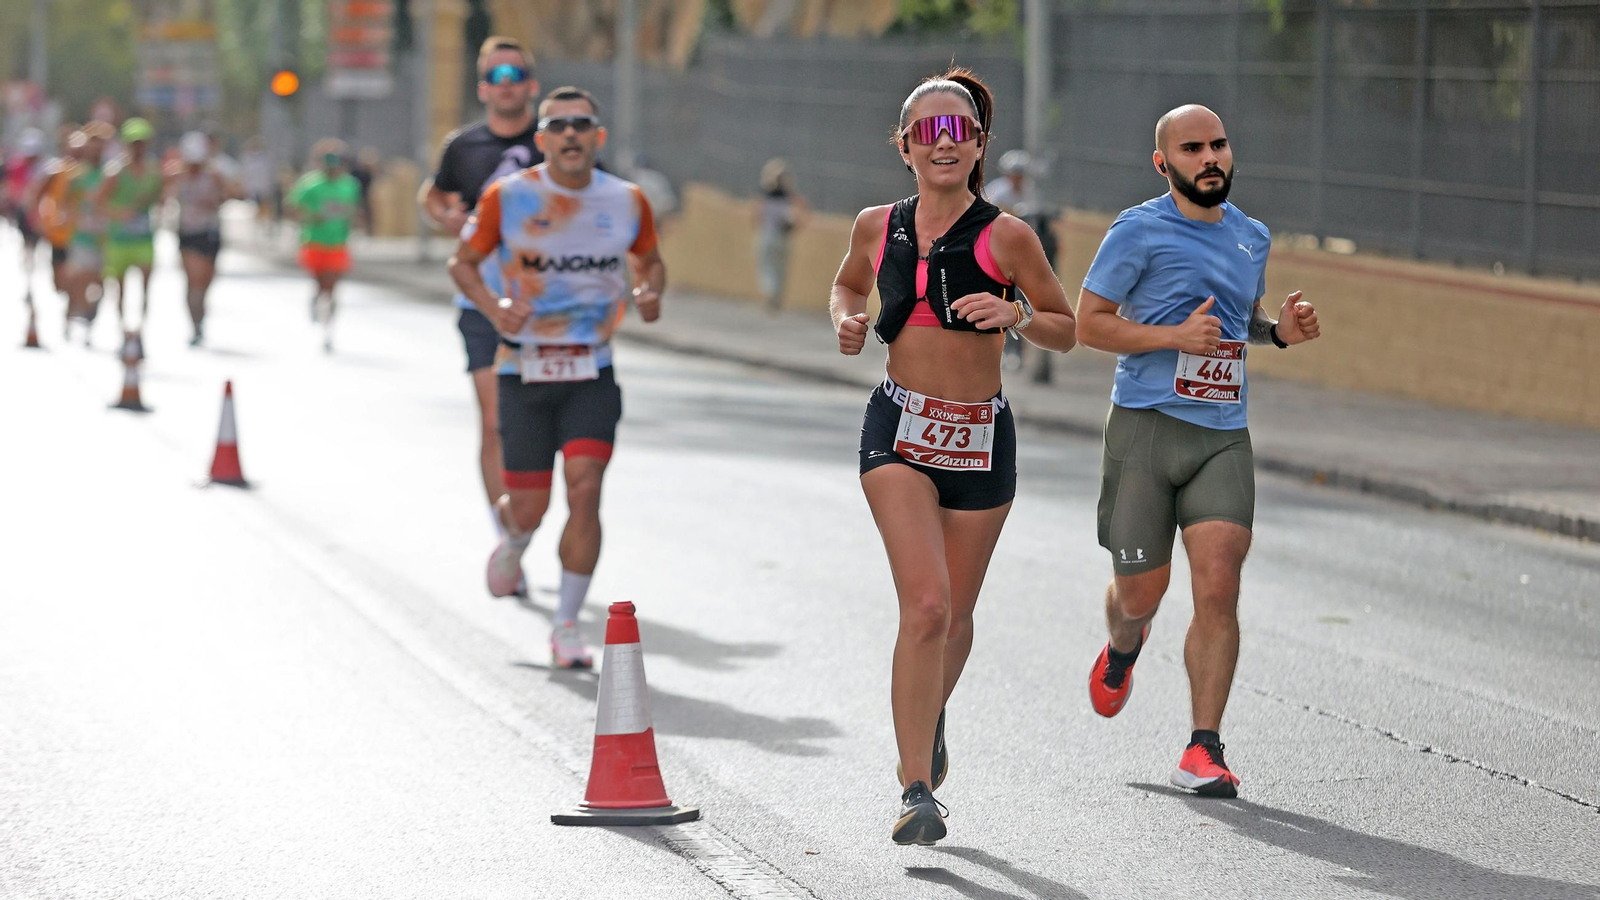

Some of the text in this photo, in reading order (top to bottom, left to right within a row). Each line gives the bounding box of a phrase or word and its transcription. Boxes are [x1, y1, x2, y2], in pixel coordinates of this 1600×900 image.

[541, 360, 577, 375] 471
[1197, 360, 1233, 382] 464
[928, 407, 953, 421] XXIX
[921, 422, 971, 448] 473
[928, 454, 984, 467] MIZUNO
